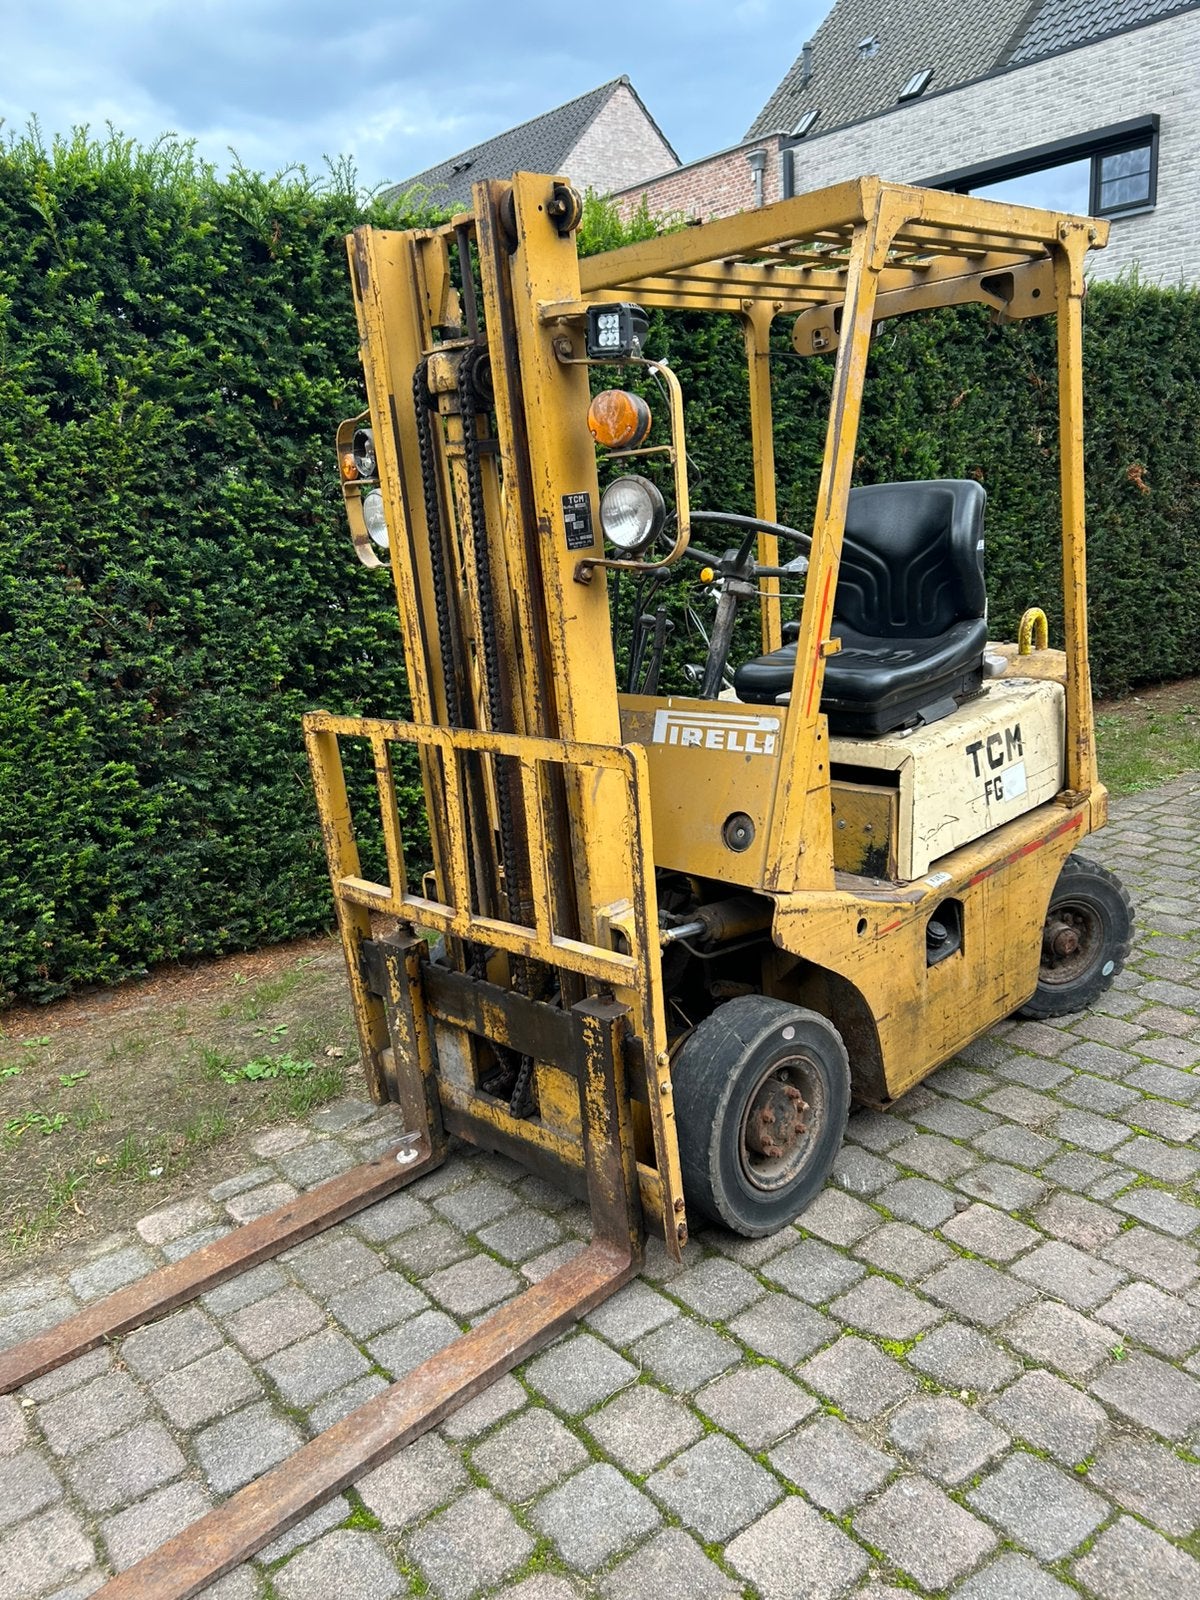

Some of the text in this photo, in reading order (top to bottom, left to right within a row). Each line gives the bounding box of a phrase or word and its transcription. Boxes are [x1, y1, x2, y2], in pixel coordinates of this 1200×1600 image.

[568, 495, 584, 504] TCM
[652, 709, 780, 755] PIRELLI
[965, 723, 1023, 778] TCM
[984, 775, 1004, 806] FG
